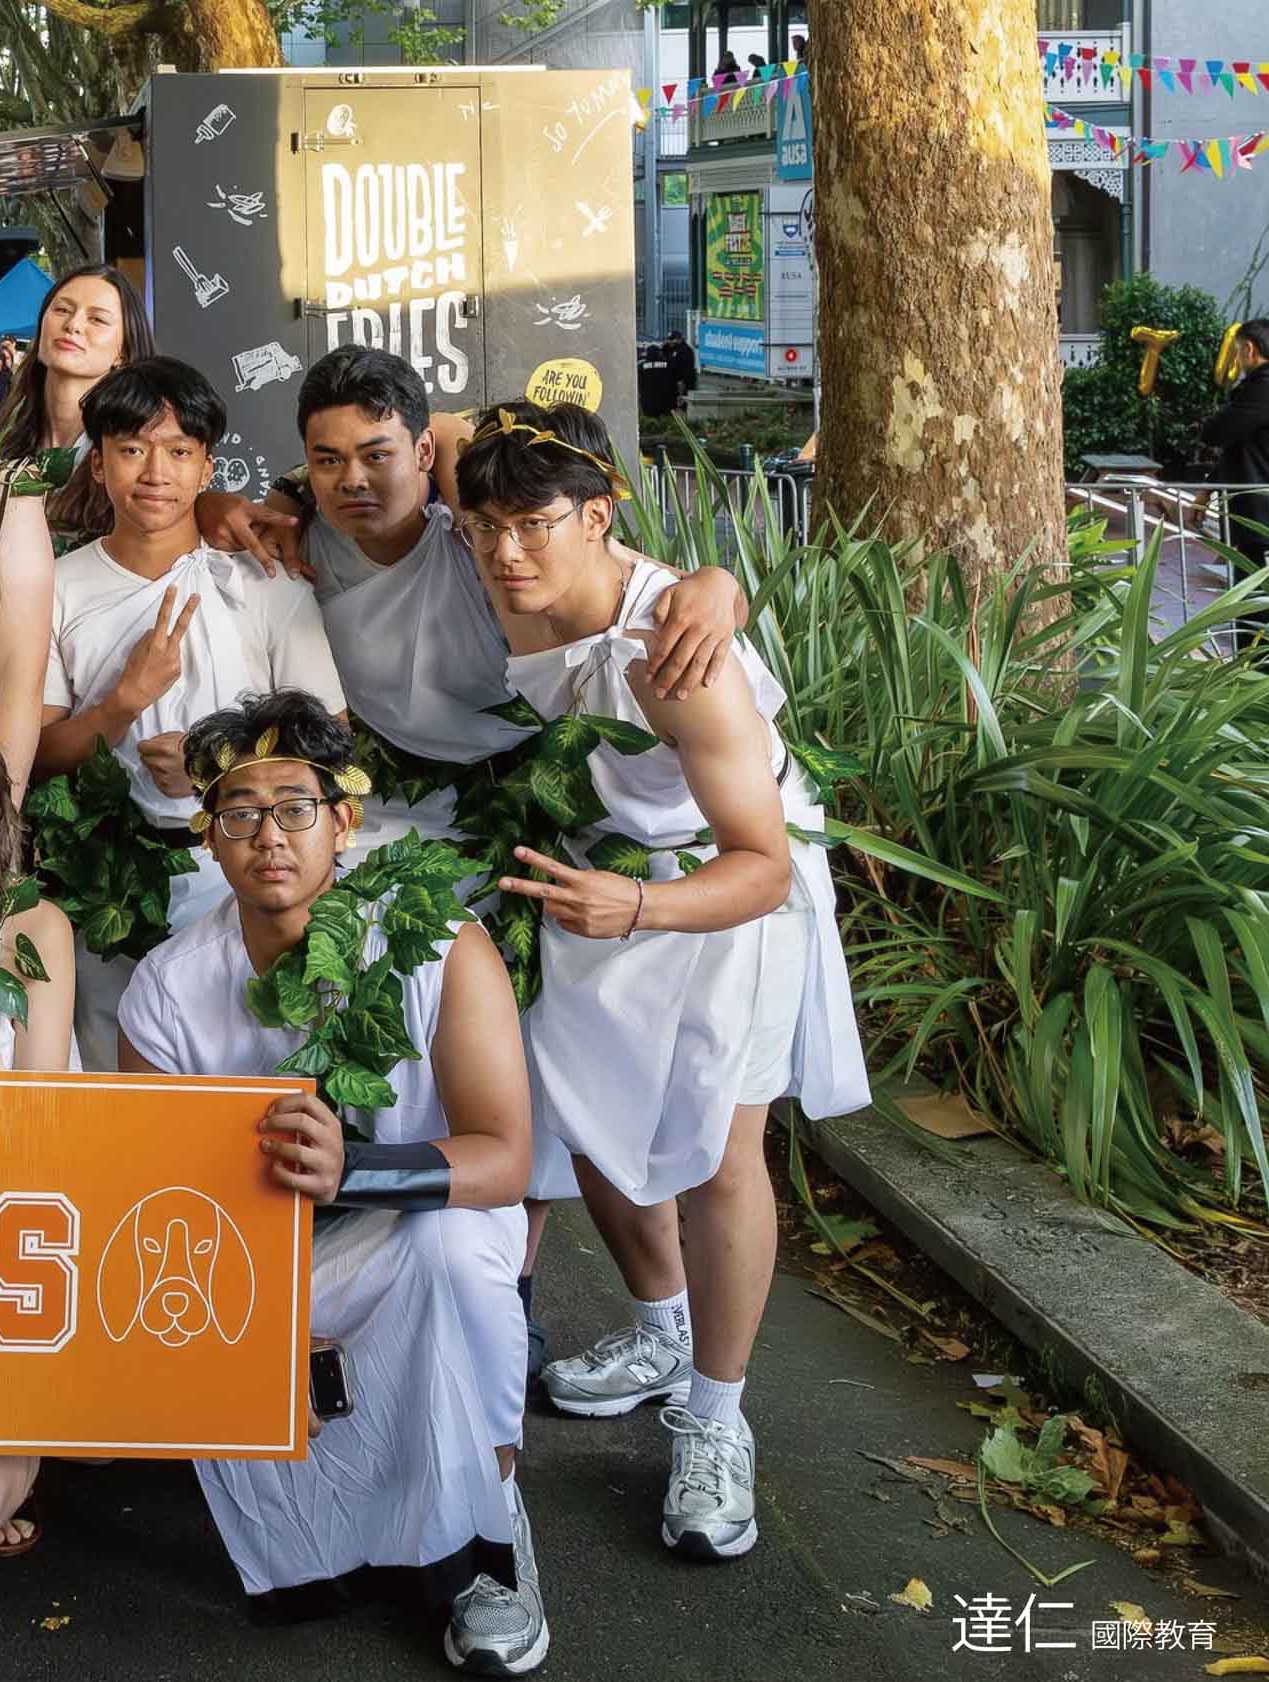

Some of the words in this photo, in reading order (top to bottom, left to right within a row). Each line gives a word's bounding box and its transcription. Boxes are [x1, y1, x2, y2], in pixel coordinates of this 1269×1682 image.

[321, 161, 467, 276] DOUBLE
[325, 253, 467, 308] DUTCH
[542, 370, 563, 387] ARE
[565, 373, 588, 390] YOU
